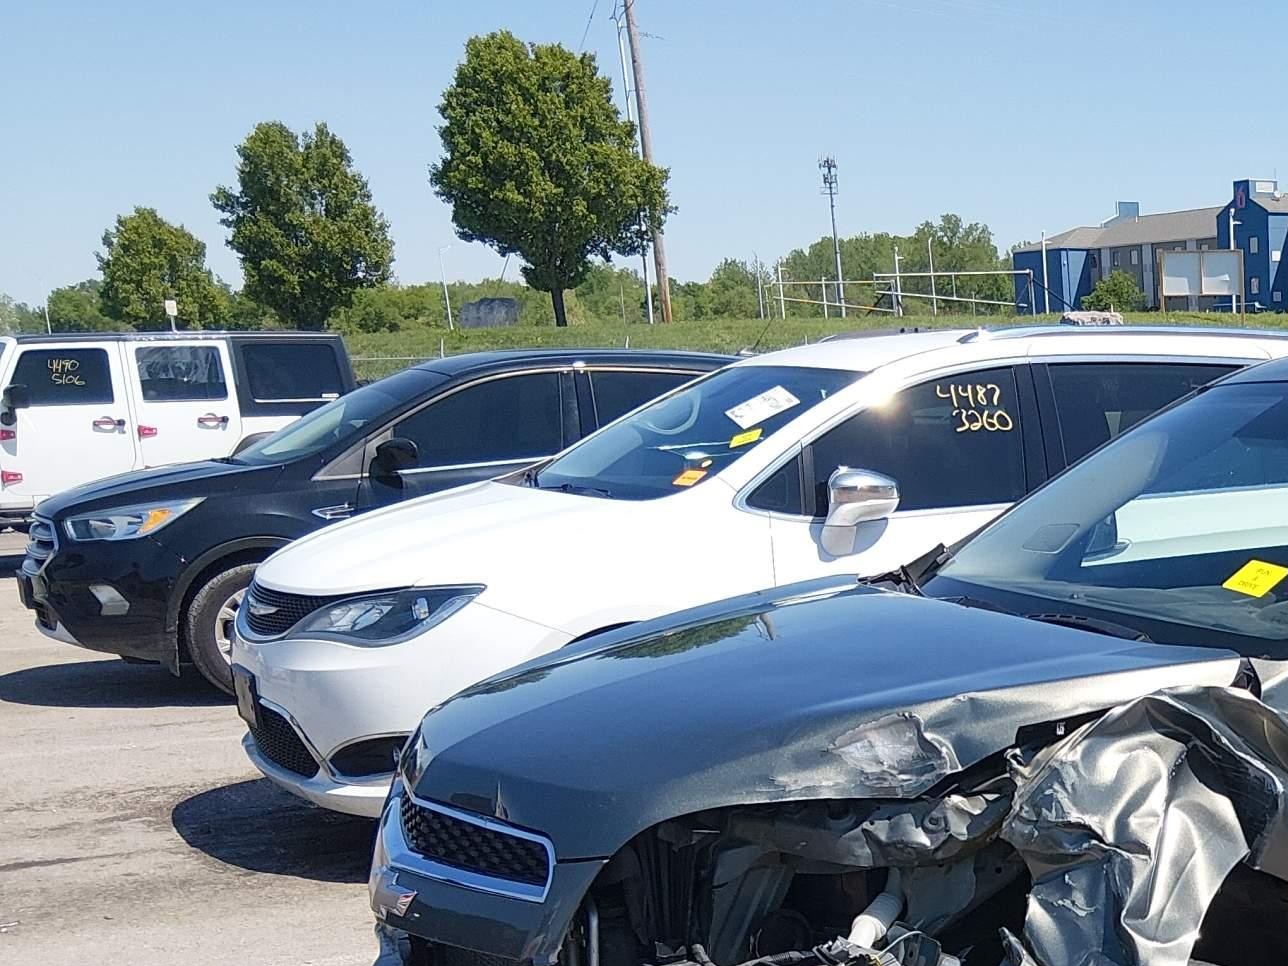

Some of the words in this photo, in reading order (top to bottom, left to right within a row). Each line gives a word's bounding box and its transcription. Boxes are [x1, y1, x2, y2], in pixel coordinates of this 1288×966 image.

[47, 358, 80, 373] 4490
[51, 373, 86, 386] 5106
[936, 383, 1001, 408] 4487
[952, 408, 1013, 432] 3260
